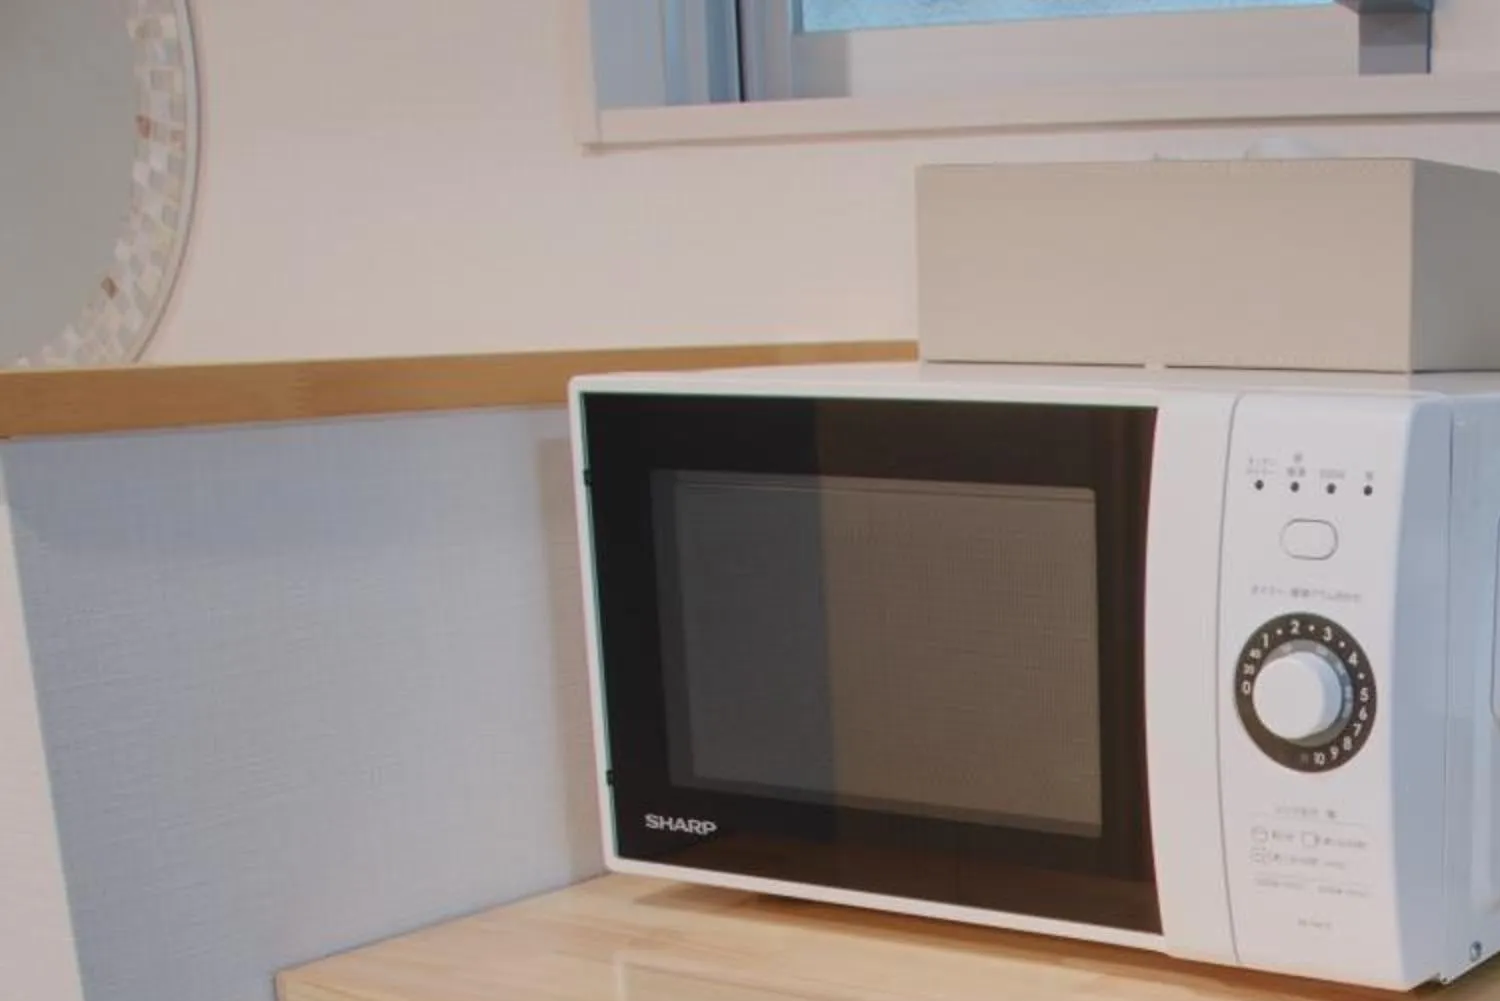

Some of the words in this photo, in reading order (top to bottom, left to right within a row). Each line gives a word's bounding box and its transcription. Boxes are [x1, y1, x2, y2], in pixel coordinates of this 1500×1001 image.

[1290, 620, 1300, 634] 2
[1323, 627, 1333, 642] 3
[1348, 652, 1358, 667] 4
[1360, 688, 1369, 702] 5
[1359, 707, 1368, 721] 6
[1353, 723, 1362, 737] 7
[644, 813, 718, 835] SHARP
